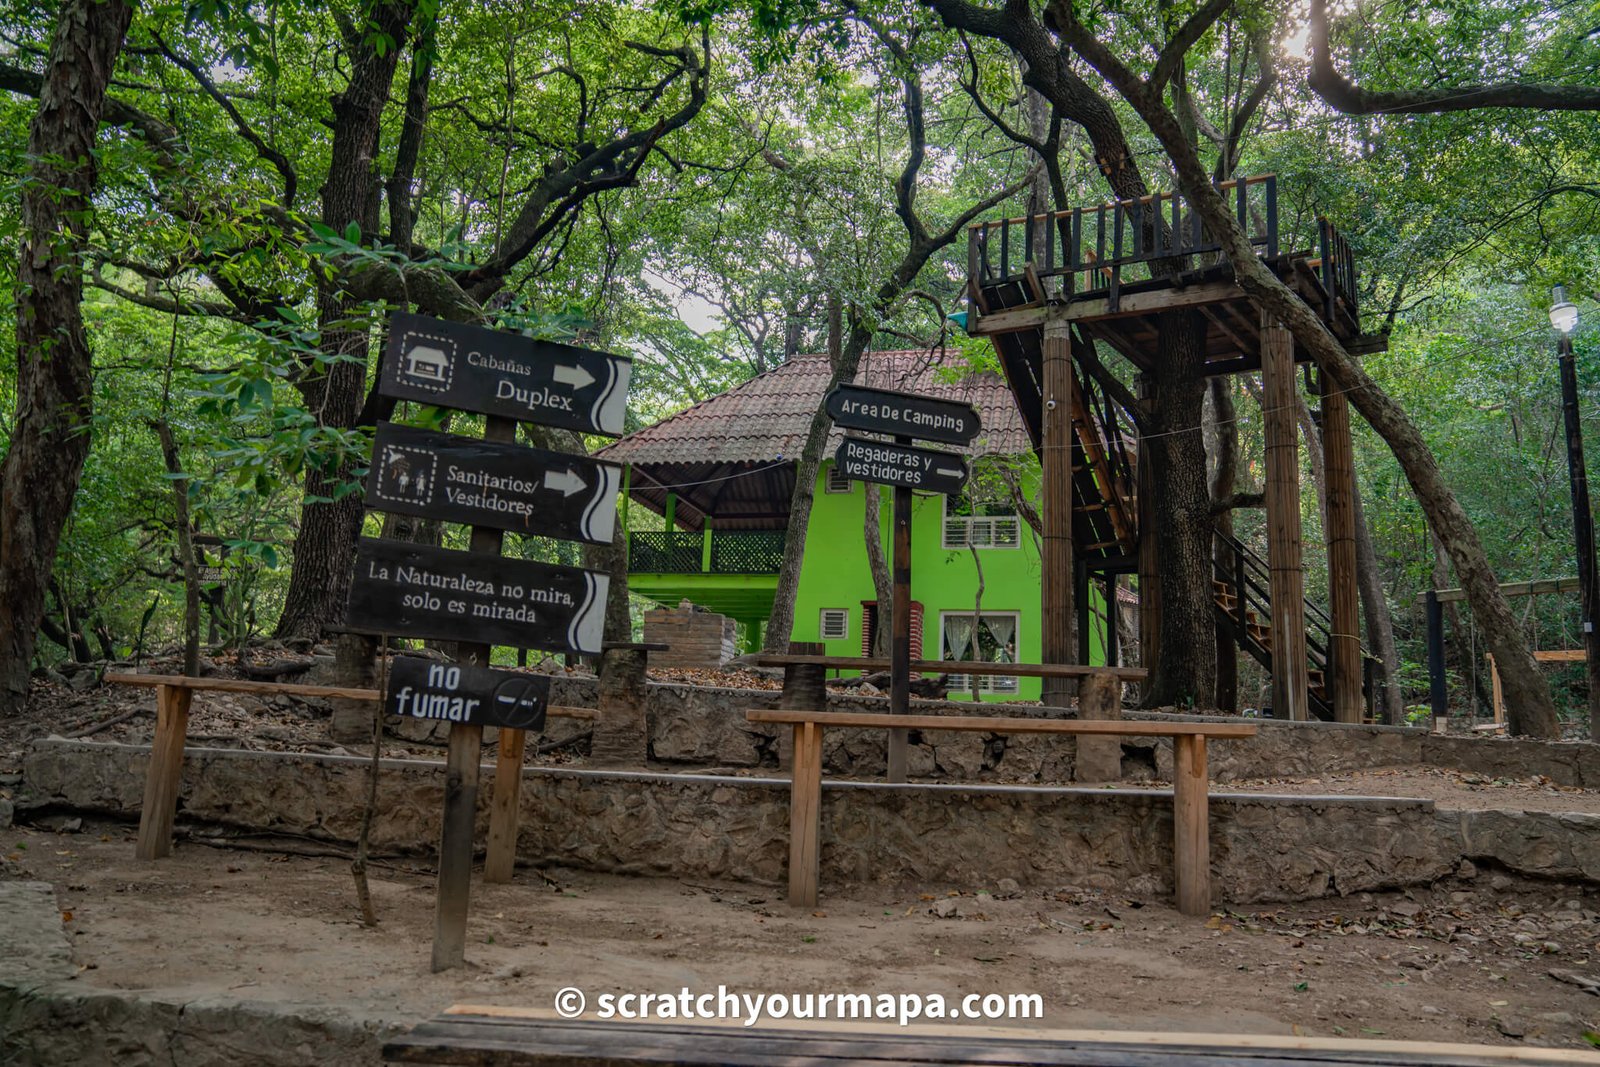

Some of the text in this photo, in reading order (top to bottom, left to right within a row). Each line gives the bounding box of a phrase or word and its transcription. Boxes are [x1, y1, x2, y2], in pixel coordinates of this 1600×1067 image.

[467, 351, 531, 376] Cabañas
[495, 380, 573, 412] Duplex
[841, 399, 964, 433] Area De Camping
[847, 443, 920, 467] Regaderas
[447, 465, 540, 494] Sanitarios/
[445, 486, 535, 516] Vestidores
[368, 561, 576, 609] La Naturaleza no mira,
[402, 591, 537, 624] solo es mirada
[428, 664, 461, 691] no
[395, 686, 480, 722] fumar
